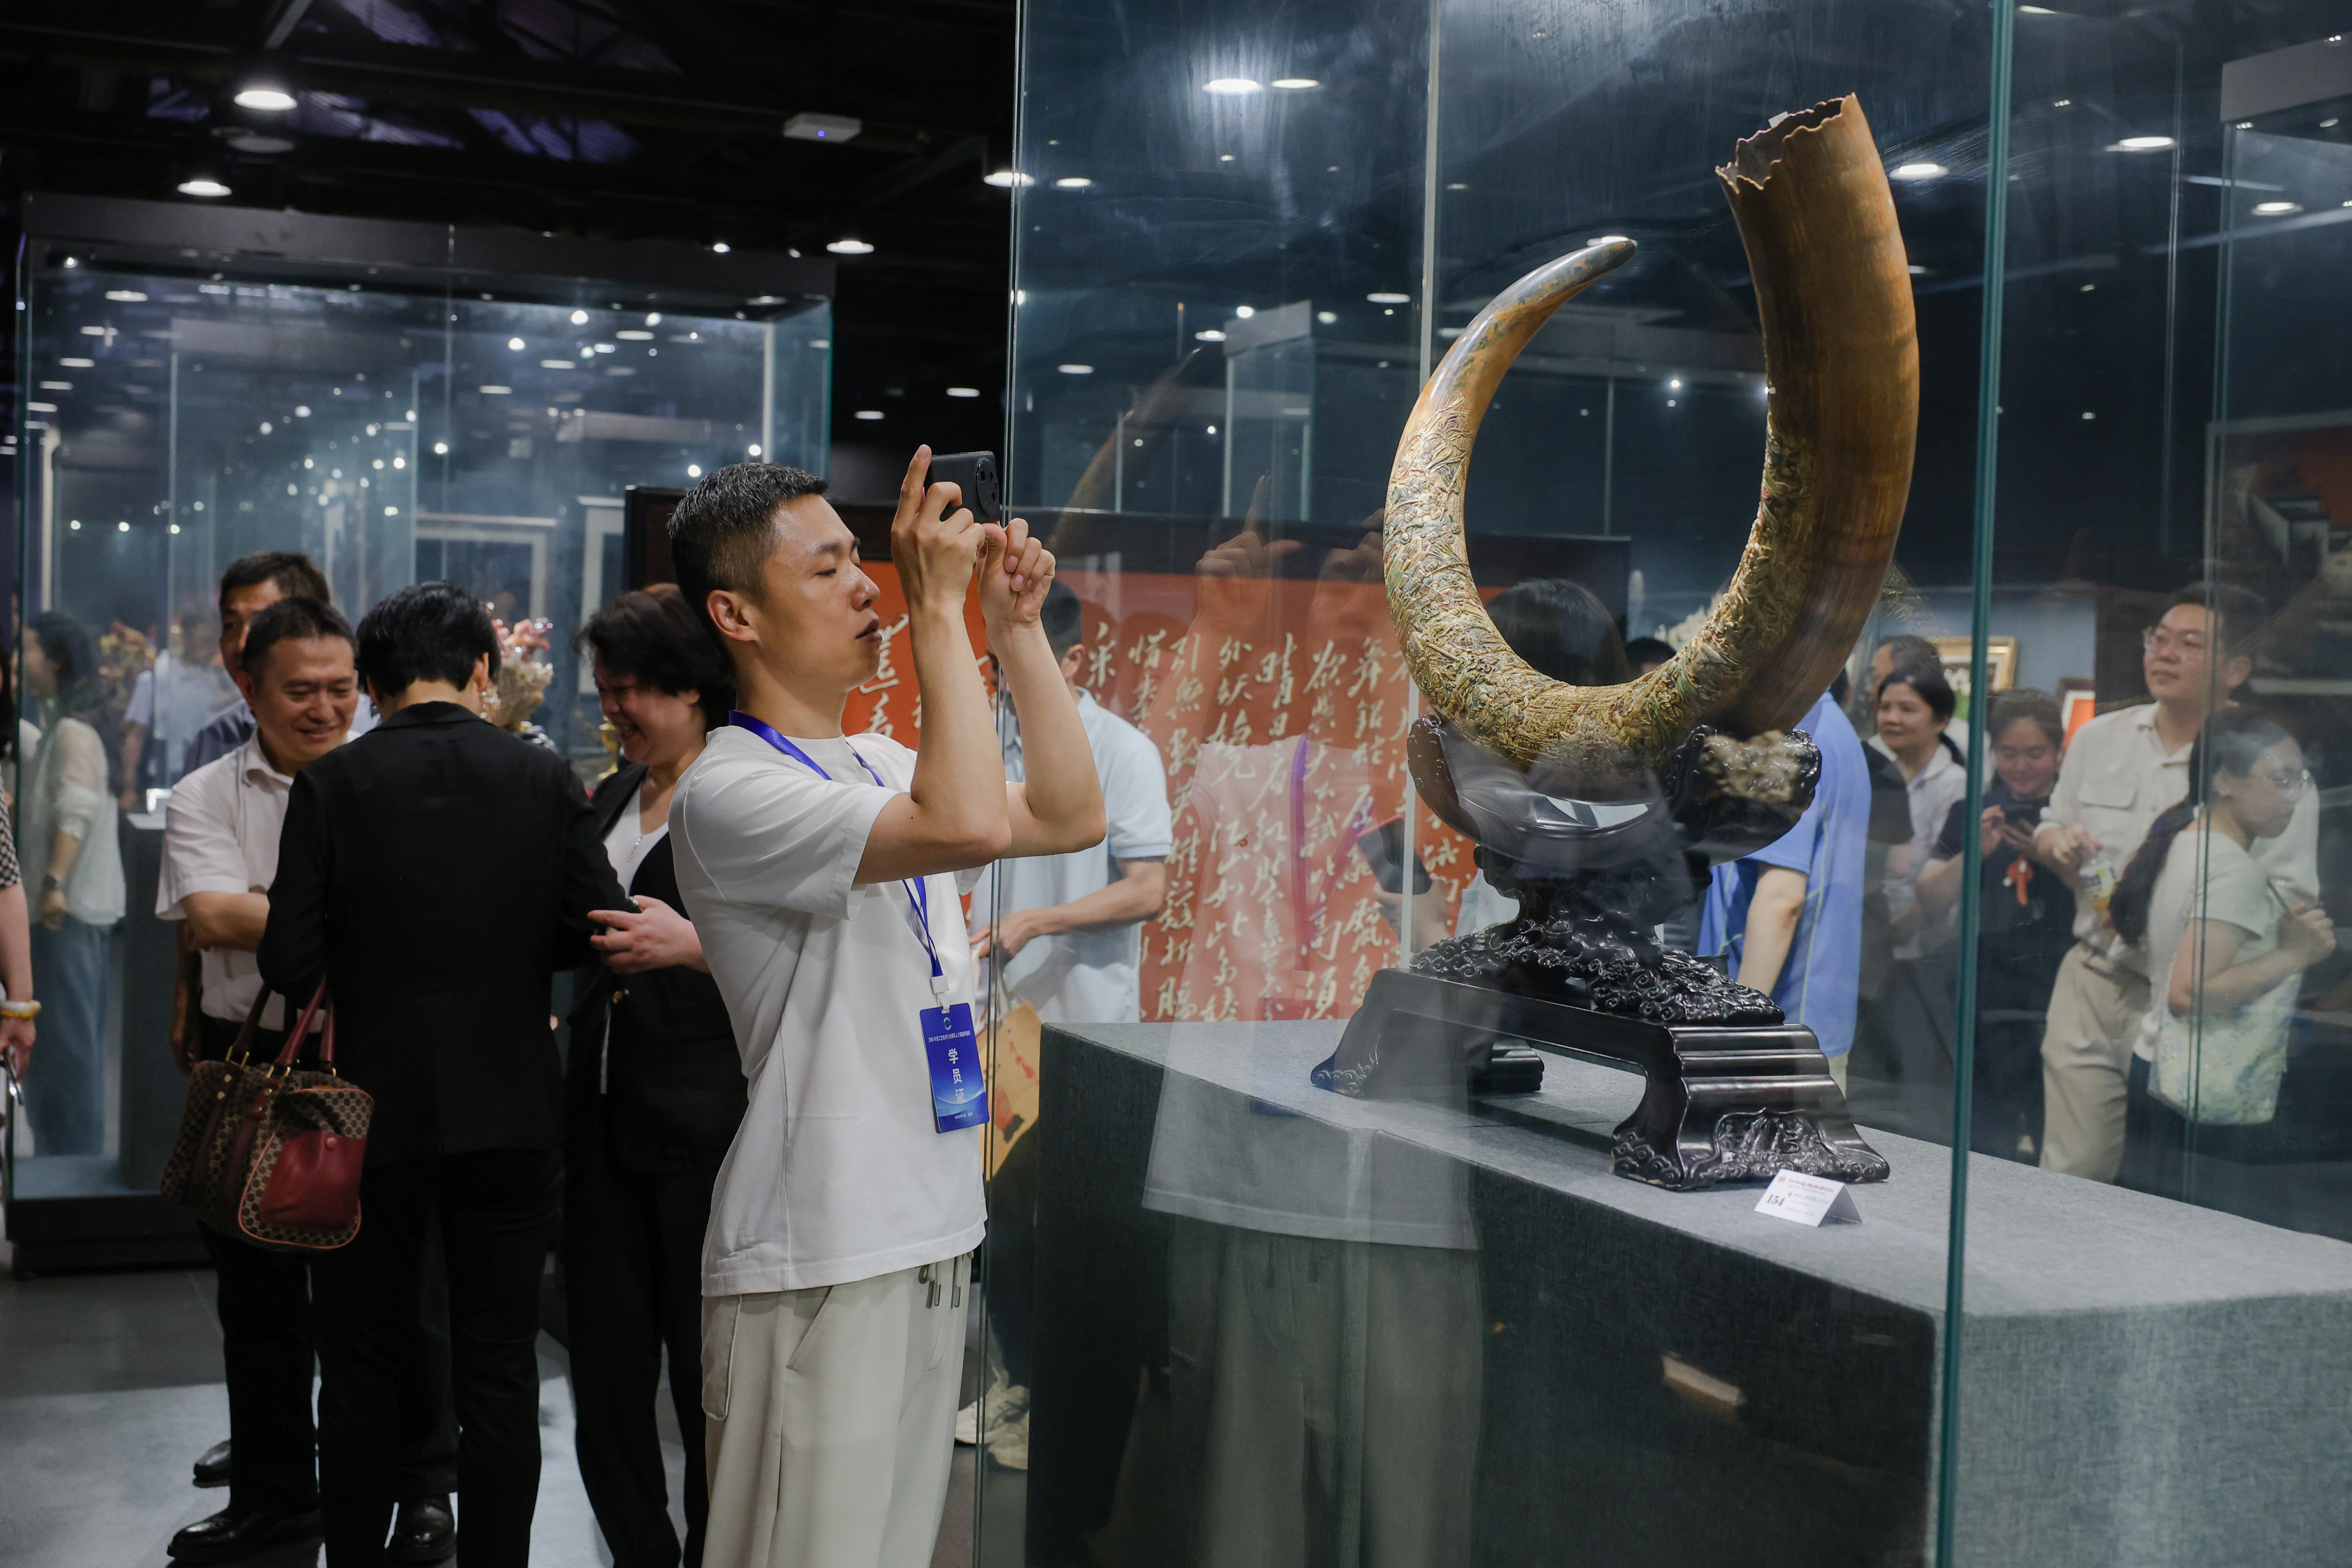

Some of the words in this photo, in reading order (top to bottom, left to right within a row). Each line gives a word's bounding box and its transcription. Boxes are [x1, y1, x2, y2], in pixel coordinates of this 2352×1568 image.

[948, 1048, 966, 1104] 学员证
[1765, 1194, 1785, 1206] 154
